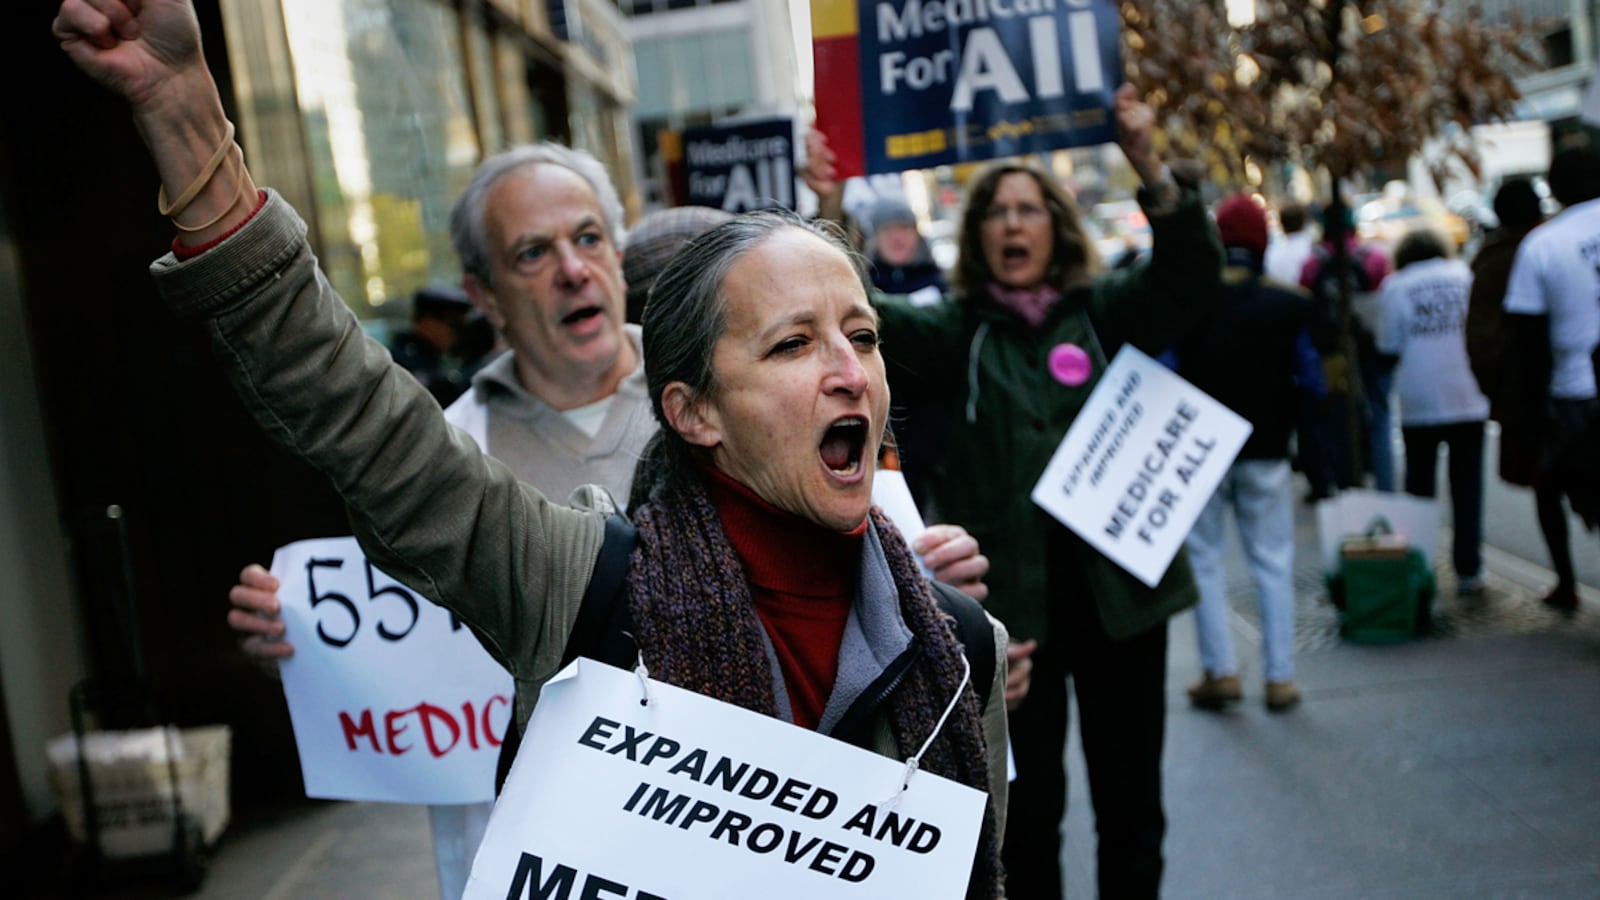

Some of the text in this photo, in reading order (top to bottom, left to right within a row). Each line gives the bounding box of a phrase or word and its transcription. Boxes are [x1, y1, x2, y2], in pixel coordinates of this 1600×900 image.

[876, 0, 1093, 43] Medic
[879, 10, 1104, 112] For All
[722, 156, 793, 213] All
[1062, 369, 1141, 496] EXPANDED AND
[1089, 402, 1144, 487] IMPROVED
[1104, 400, 1199, 540] MEDICARE
[1137, 437, 1216, 546] FOR ALL
[578, 715, 942, 854] EXPANDED AND
[623, 782, 876, 884] IMPROVED
